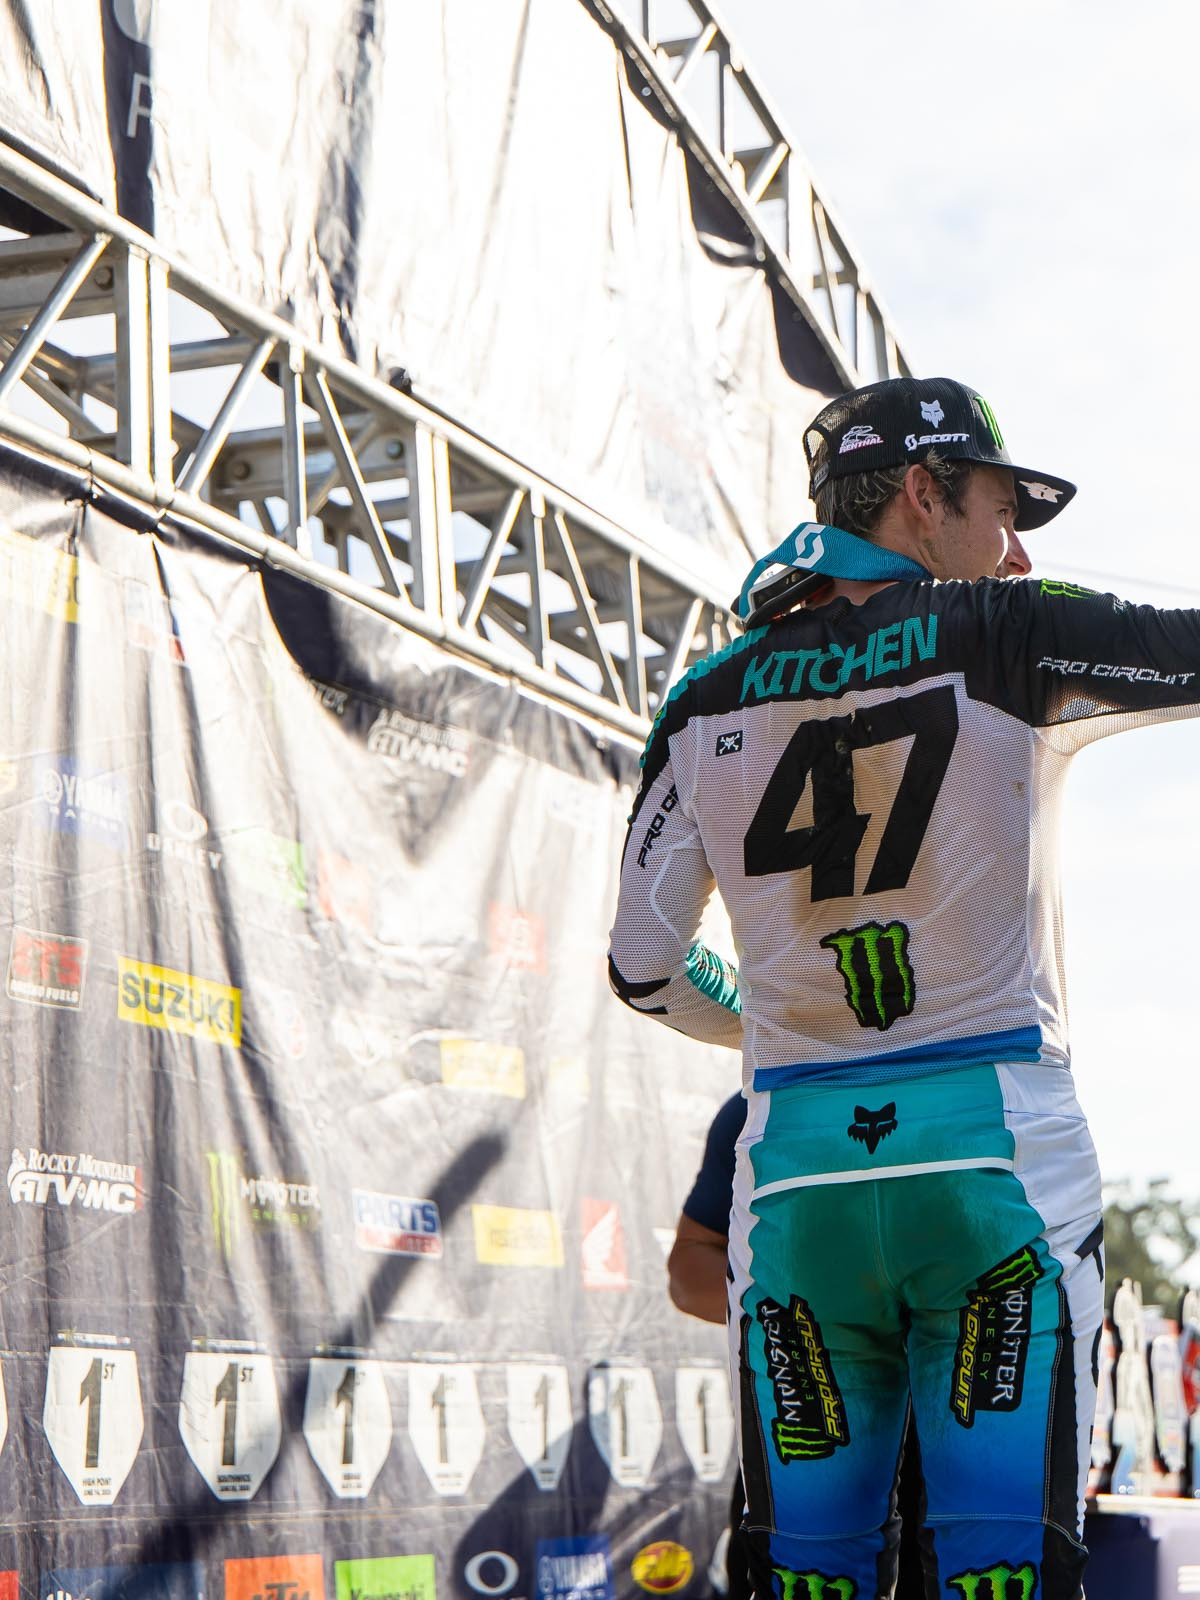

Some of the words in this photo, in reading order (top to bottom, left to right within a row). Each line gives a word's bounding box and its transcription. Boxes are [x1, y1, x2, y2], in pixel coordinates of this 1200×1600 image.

[838, 436, 885, 455] RENTHAL
[918, 433, 970, 446] SCOTT
[740, 613, 939, 703] KITCHEN
[1036, 656, 1090, 676] PRO
[1091, 663, 1196, 686] CIRCUIT
[744, 684, 959, 902] 47
[637, 812, 666, 870] PRO
[121, 972, 235, 1033] SUZUKI
[27, 1147, 78, 1173] ROCKY
[761, 1304, 803, 1422] MONSTER
[795, 1302, 830, 1383] CIRCUIT
[954, 1314, 979, 1419] CIRCUIT
[819, 1385, 842, 1438] PRO
